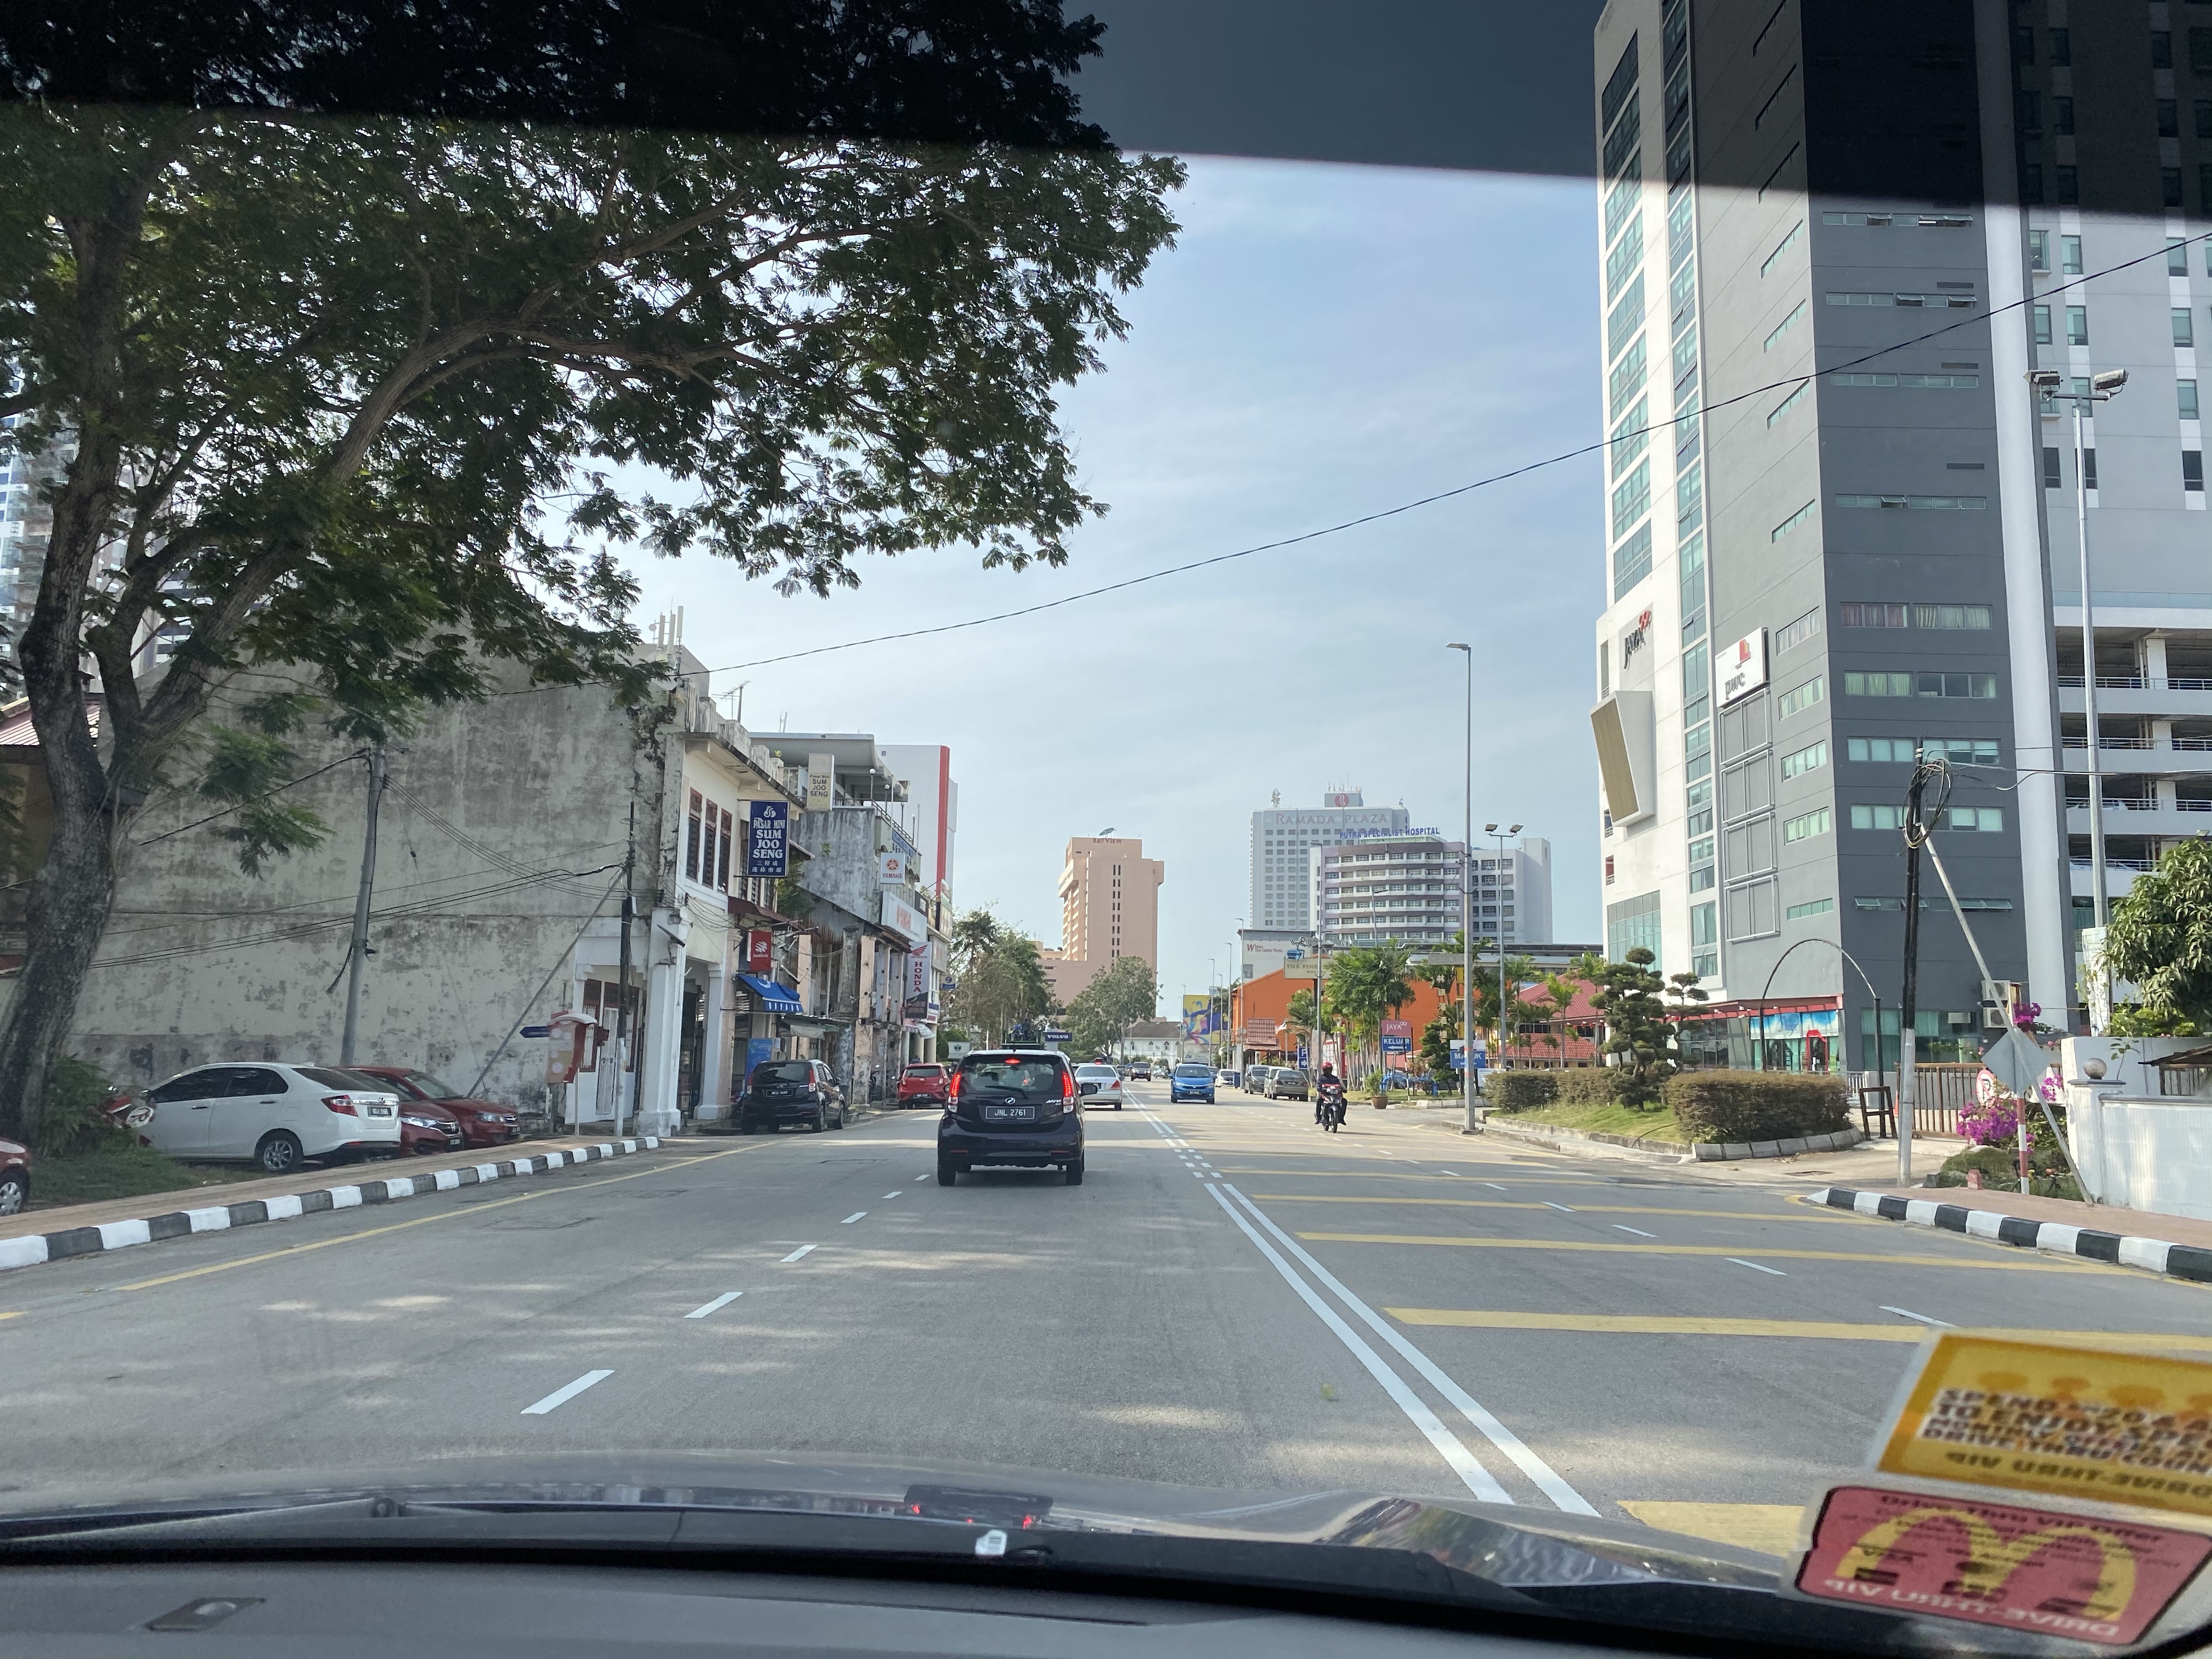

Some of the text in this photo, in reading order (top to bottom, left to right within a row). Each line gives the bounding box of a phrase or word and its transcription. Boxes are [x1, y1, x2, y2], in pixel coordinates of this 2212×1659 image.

[1624, 627, 1644, 669] JAYA
[1724, 673, 1745, 700] pwc
[753, 817, 785, 829] PASAR MINI
[1276, 813, 1387, 825] RAMADA PLAZA
[755, 830, 782, 839] SUM
[1364, 829, 1403, 838] SPECIALIST
[1406, 827, 1440, 836] HOSPITAL
[757, 839, 780, 849] JOO
[753, 849, 783, 859] SENG
[913, 961, 923, 992] HONDA
[1386, 1024, 1402, 1033] JAYA
